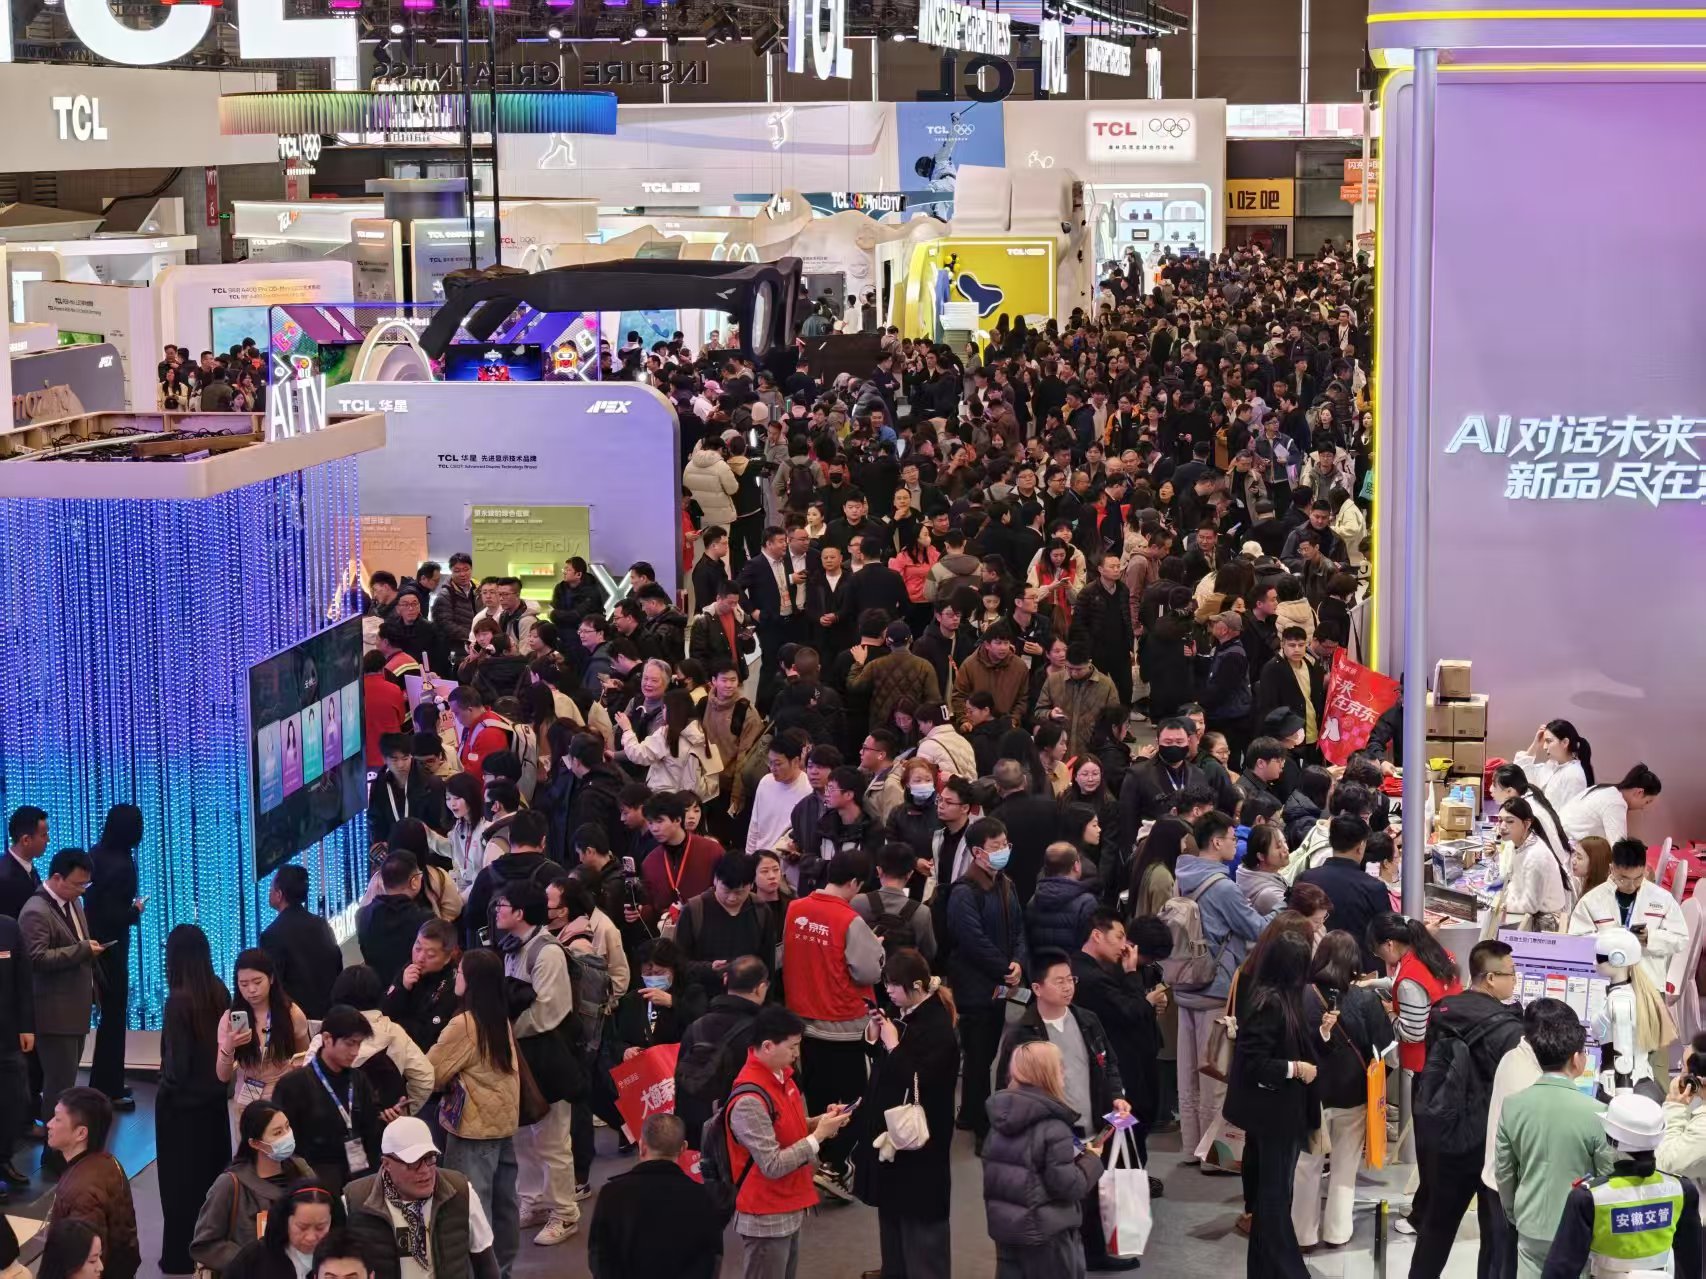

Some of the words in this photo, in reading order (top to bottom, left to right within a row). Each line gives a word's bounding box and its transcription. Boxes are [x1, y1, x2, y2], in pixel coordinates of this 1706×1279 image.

[53, 95, 108, 141] TCL
[926, 126, 949, 134] TCL
[1093, 122, 1137, 136] TCL
[279, 136, 299, 159] TCL
[832, 191, 849, 209] TCL
[1229, 190, 1280, 210] 吃吧
[339, 400, 375, 412] TCL
[379, 400, 408, 412] 华星
[586, 400, 632, 414] APEX
[1504, 461, 1706, 508] 新品尽在
[475, 537, 583, 554] Eco-friendly
[1332, 694, 1381, 726] 在京东
[809, 922, 830, 937] 京东
[1616, 1207, 1670, 1228] 安徽交管
